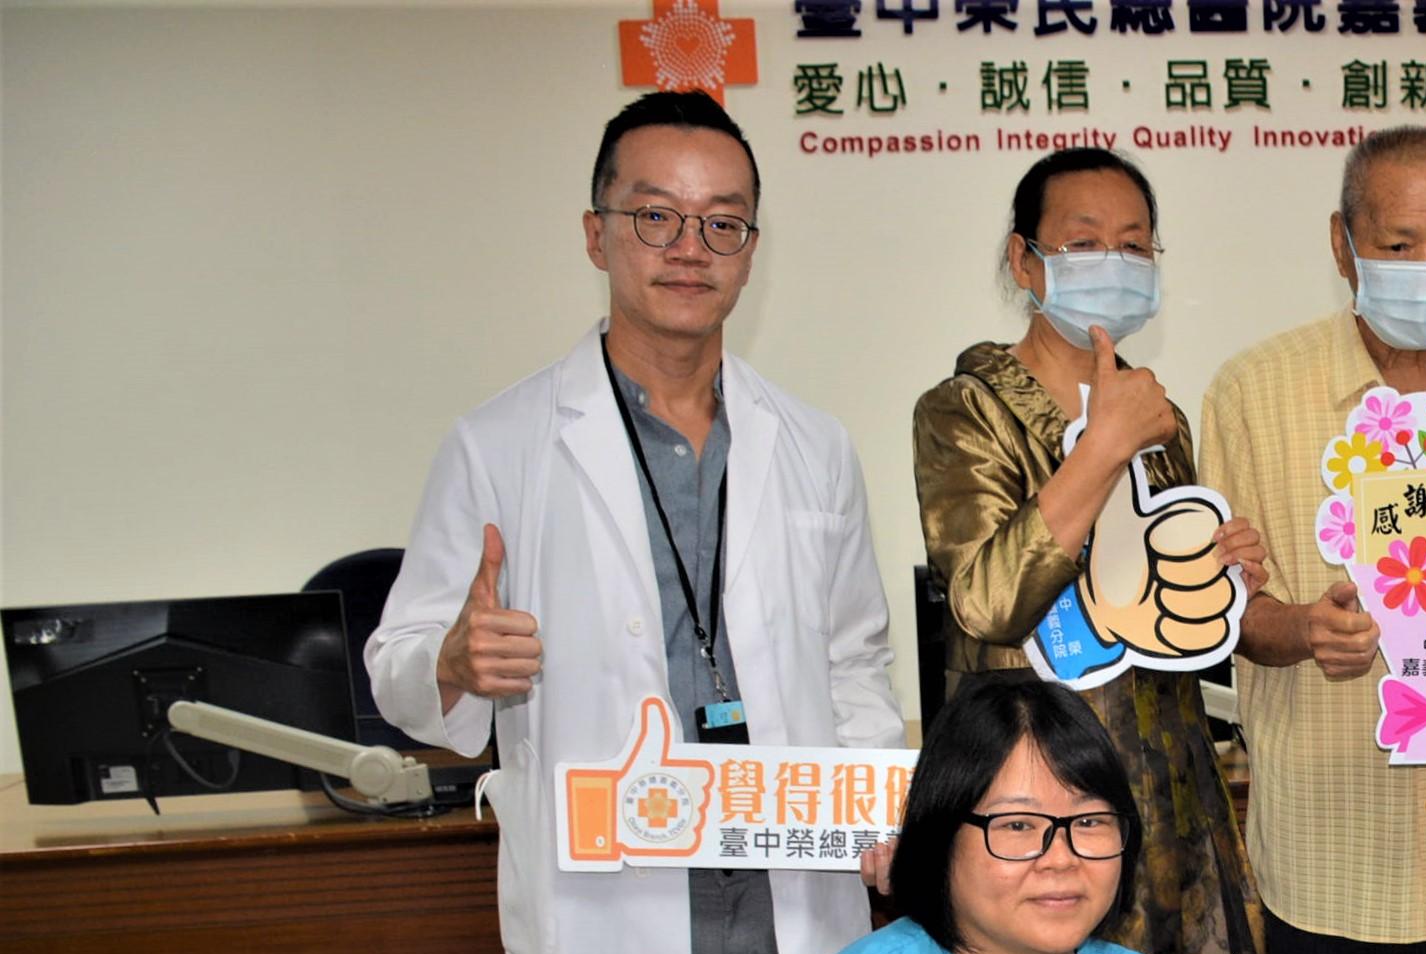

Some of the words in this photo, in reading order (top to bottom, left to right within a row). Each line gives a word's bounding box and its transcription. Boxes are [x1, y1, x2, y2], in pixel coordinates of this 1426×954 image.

[794, 62, 907, 116] 愛心
[980, 60, 1089, 113] 誠信
[1165, 58, 1271, 110] 品質
[800, 129, 980, 157] Compassion
[998, 127, 1117, 151] Integrity
[1133, 125, 1232, 151] Quality
[719, 826, 898, 859] 臺中榮總嘉
